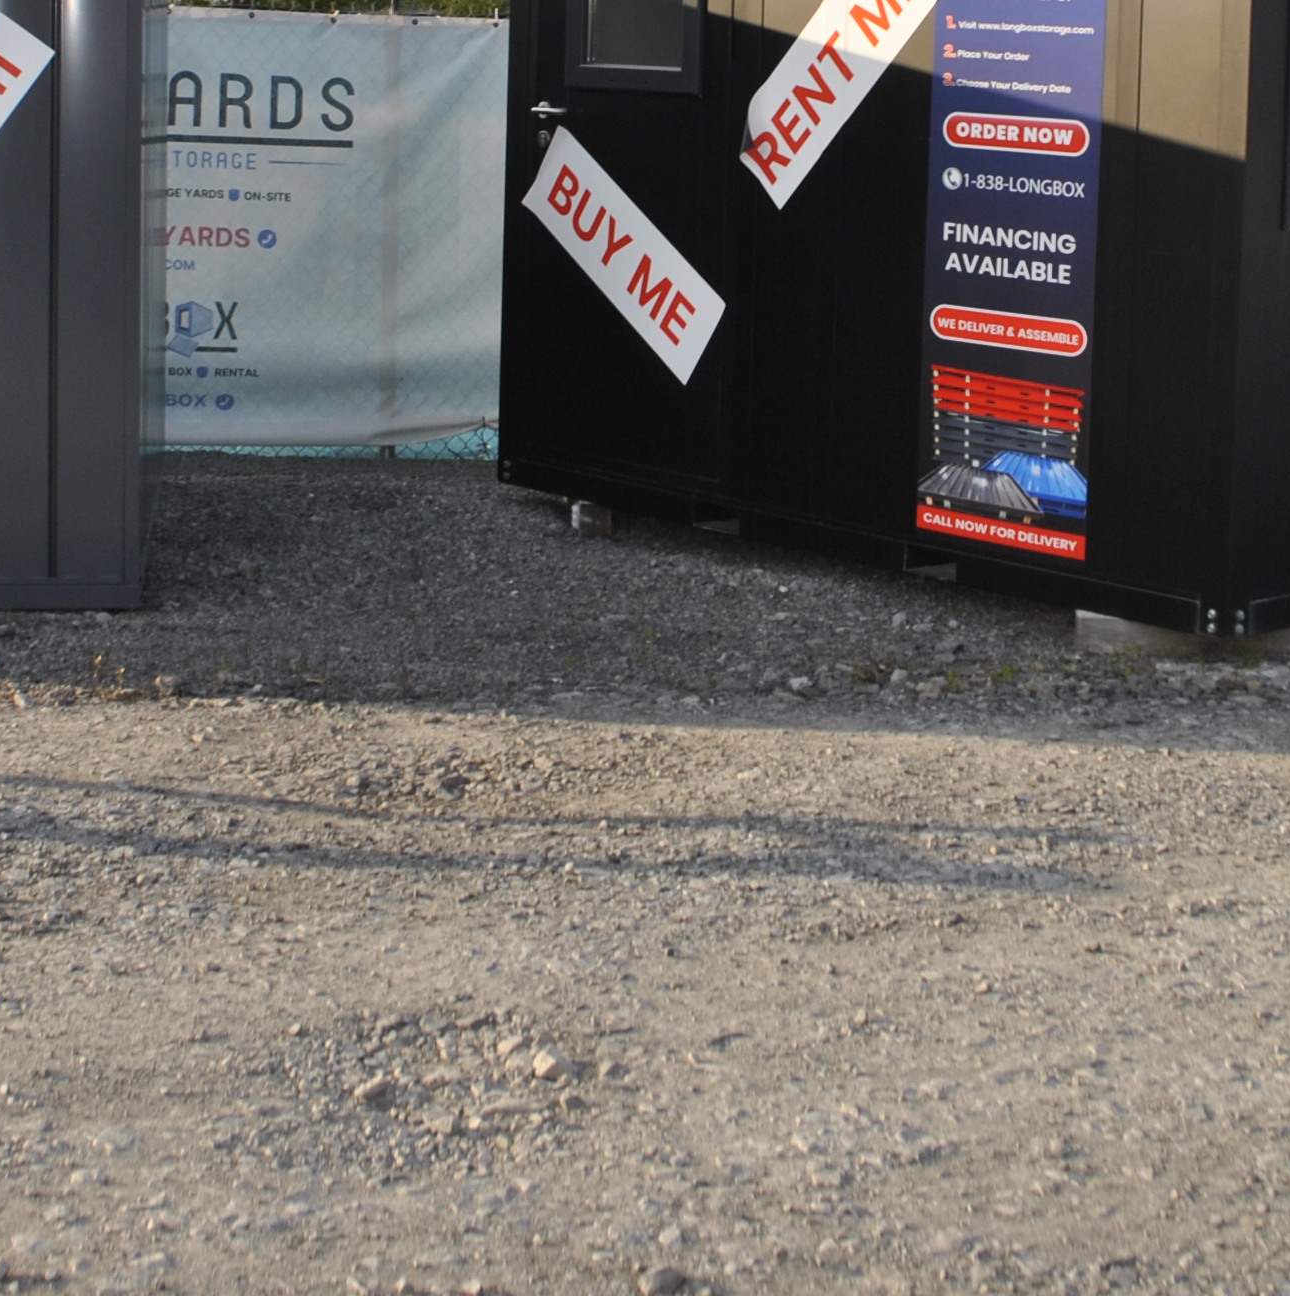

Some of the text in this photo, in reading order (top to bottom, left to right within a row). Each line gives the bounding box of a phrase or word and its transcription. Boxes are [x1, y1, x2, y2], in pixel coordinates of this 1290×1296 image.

[958, 21, 977, 30] Visit
[957, 49, 981, 59] Place
[982, 51, 1003, 60] Your
[1004, 52, 1030, 61] Order
[956, 79, 989, 89] Choose
[991, 81, 1011, 90] Your
[1012, 82, 1049, 94] Delivery
[1049, 84, 1072, 94] Date
[746, 31, 855, 186] RENT
[955, 121, 1073, 146] ORDER NOW
[185, 189, 224, 199] YARDS
[244, 191, 292, 202] ON-SITE
[963, 173, 1085, 199] 1-838-LONGBOX
[942, 221, 1077, 254] FINANCING
[546, 164, 697, 347] BUY ME
[945, 252, 1072, 285] AVAILABLE
[937, 317, 1080, 346] WE DELIVER & ASSEMBLE
[168, 367, 260, 378] BOX RENTAL
[923, 512, 1077, 552] CALL NOW FOR DELIVERY
